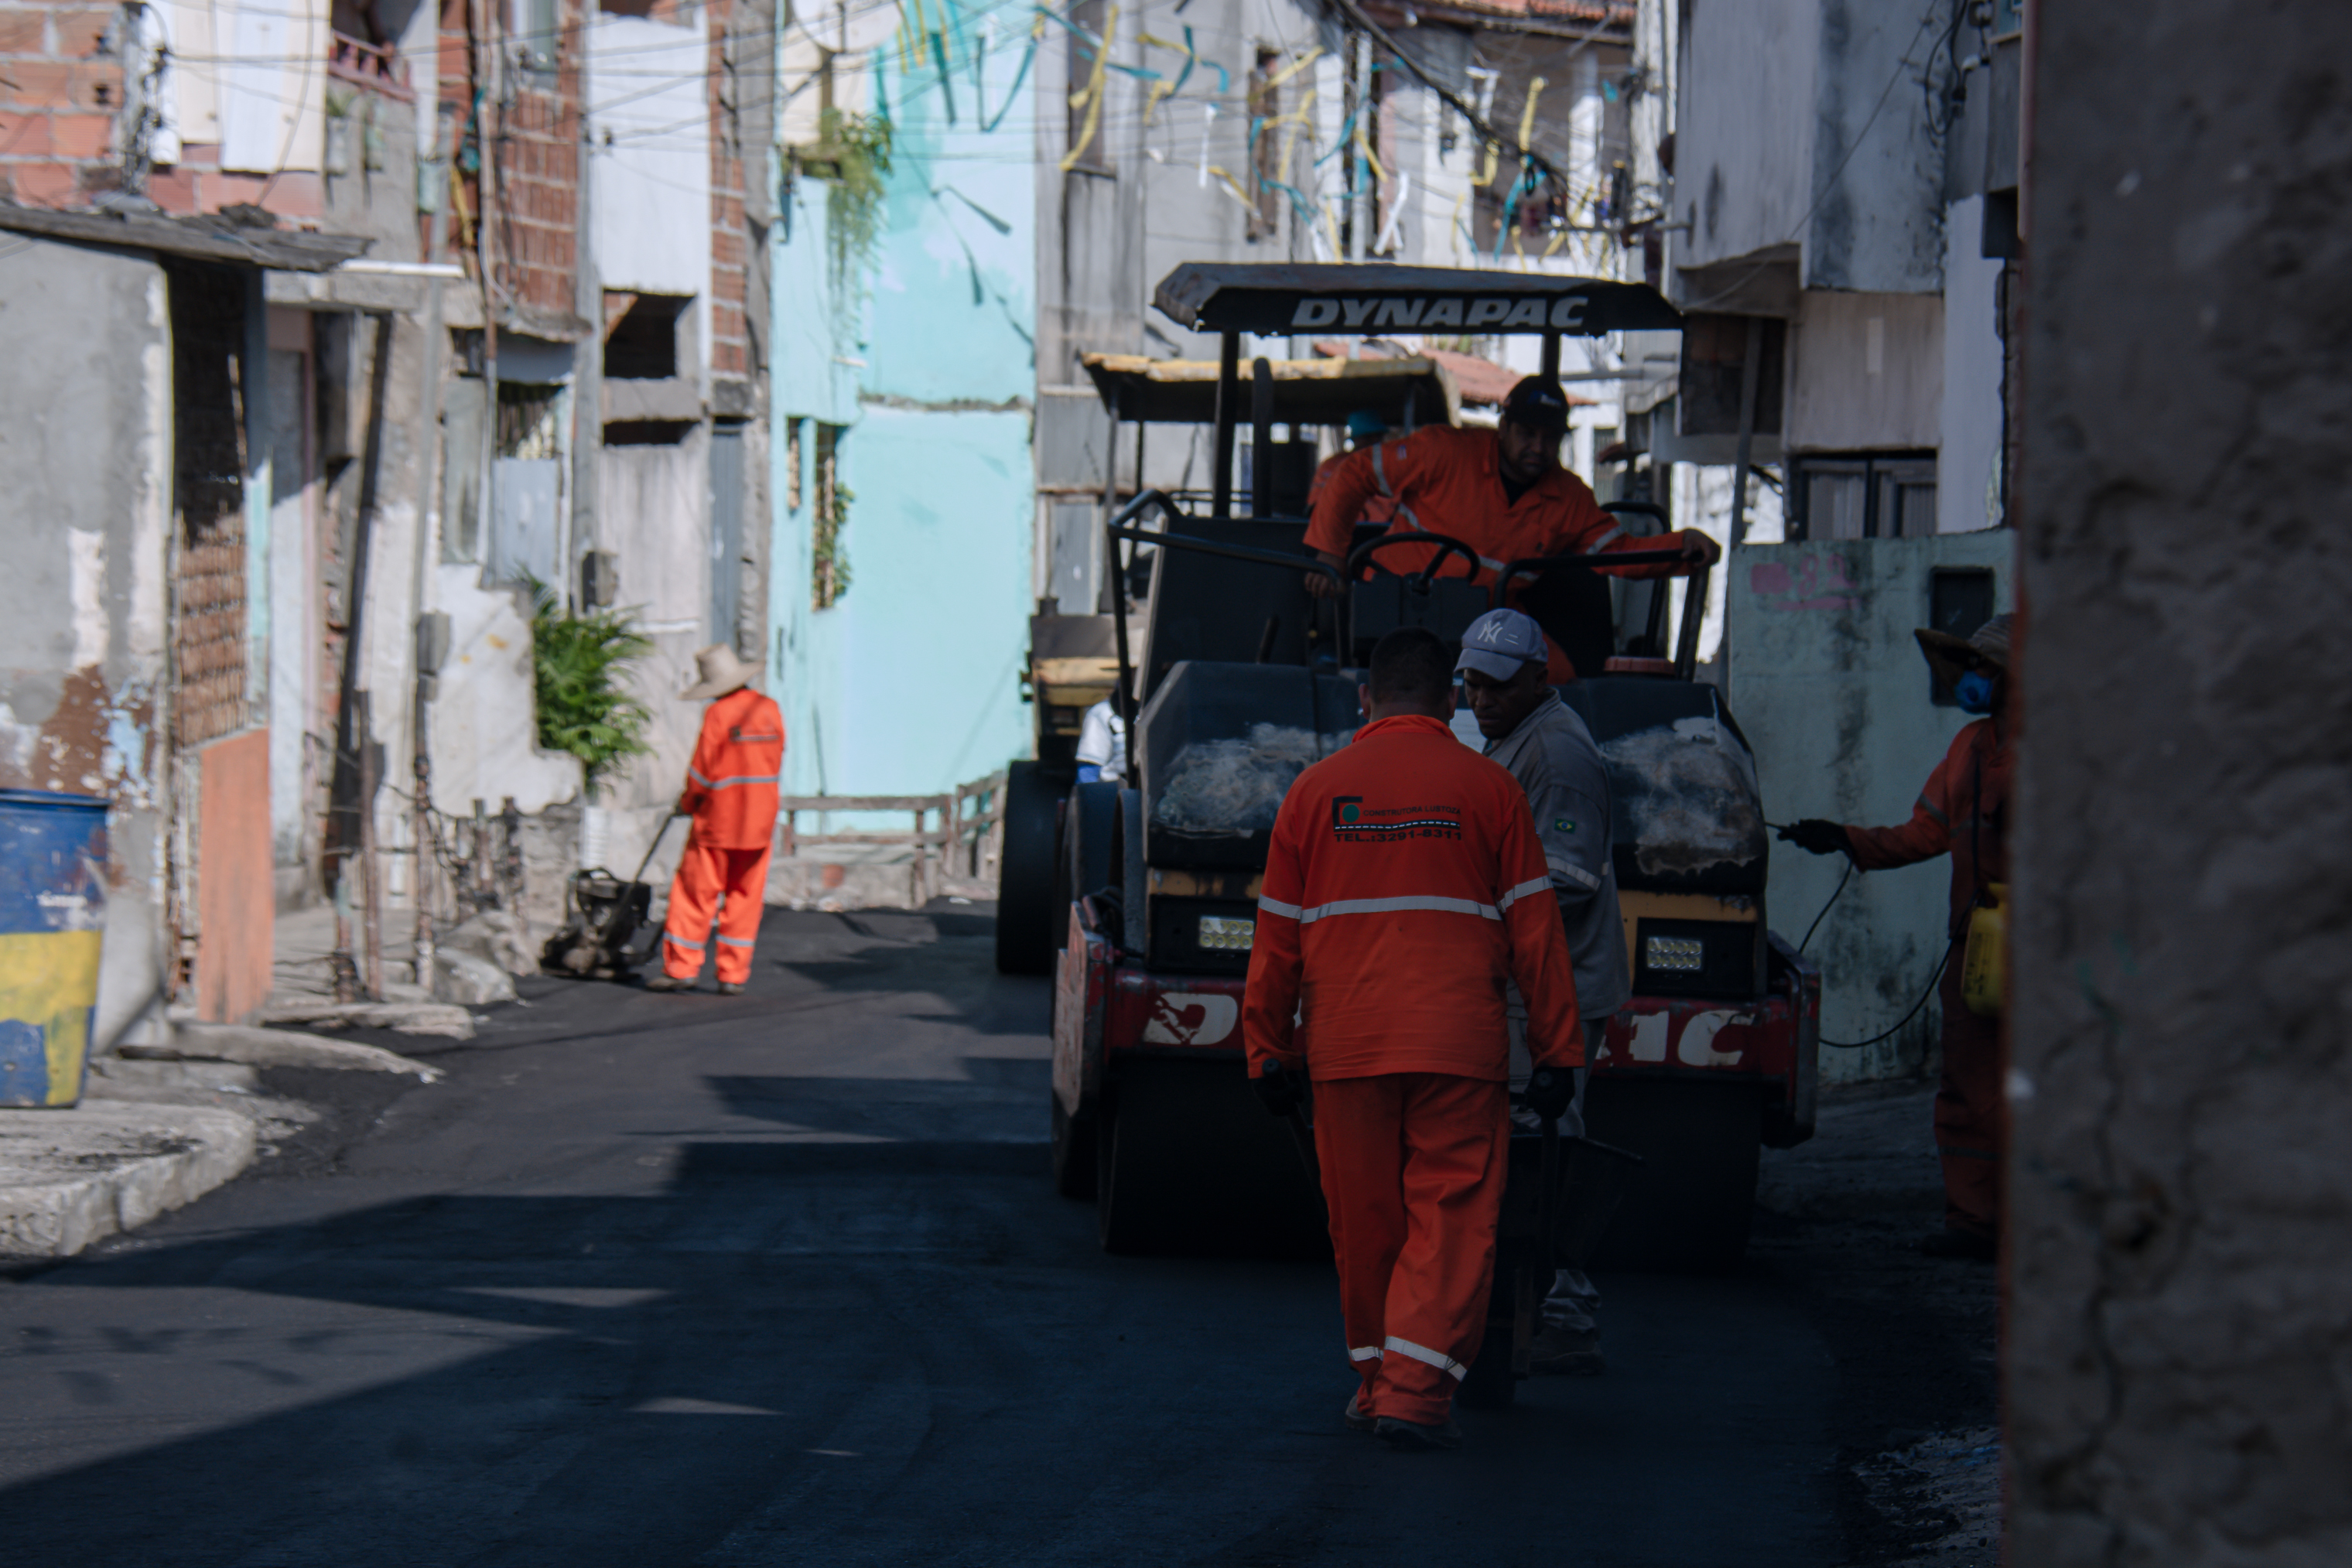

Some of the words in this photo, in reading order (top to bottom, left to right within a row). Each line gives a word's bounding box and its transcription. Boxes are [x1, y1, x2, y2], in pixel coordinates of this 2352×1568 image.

[1291, 297, 1588, 328] DYNAPAC
[1477, 620, 1504, 644] NY
[1363, 806, 1423, 817] CONSTRUTORA
[1425, 805, 1461, 815] LUSTOZA
